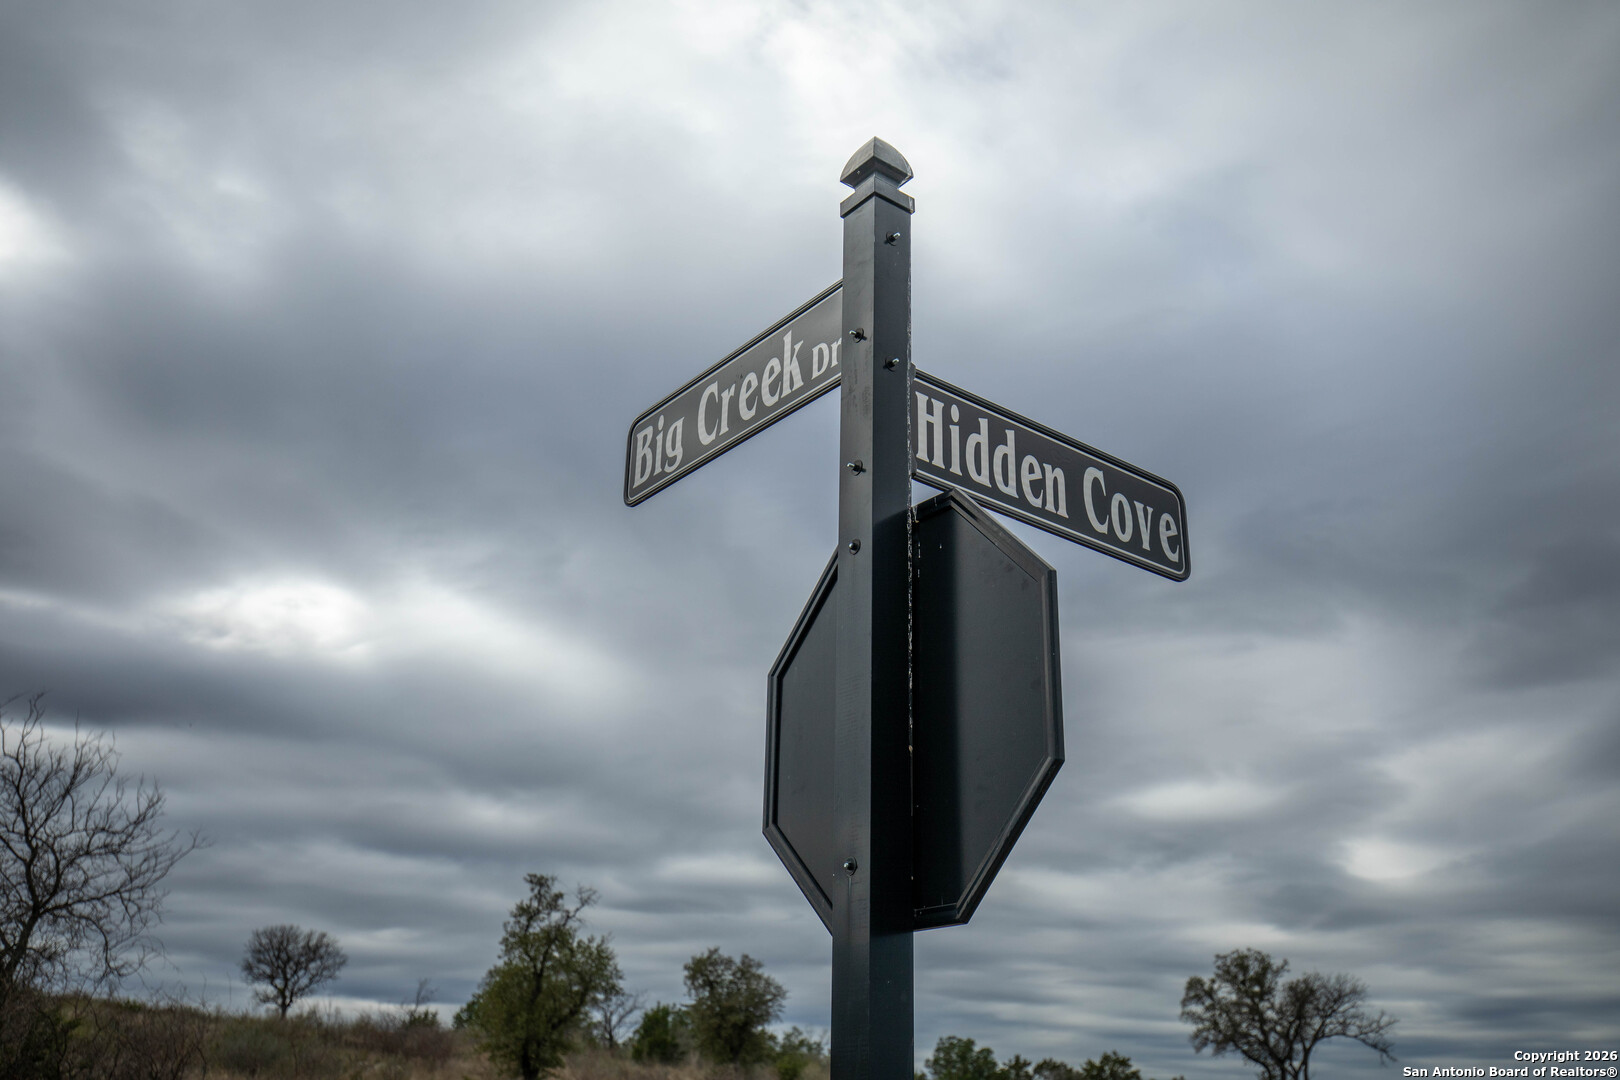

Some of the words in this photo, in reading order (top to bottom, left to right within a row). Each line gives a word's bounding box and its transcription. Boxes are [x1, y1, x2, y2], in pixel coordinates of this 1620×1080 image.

[632, 414, 685, 489] Big
[697, 329, 804, 446] Creek
[811, 337, 842, 380] Dr
[915, 391, 1069, 519] Hidden
[1083, 466, 1180, 563] Cove
